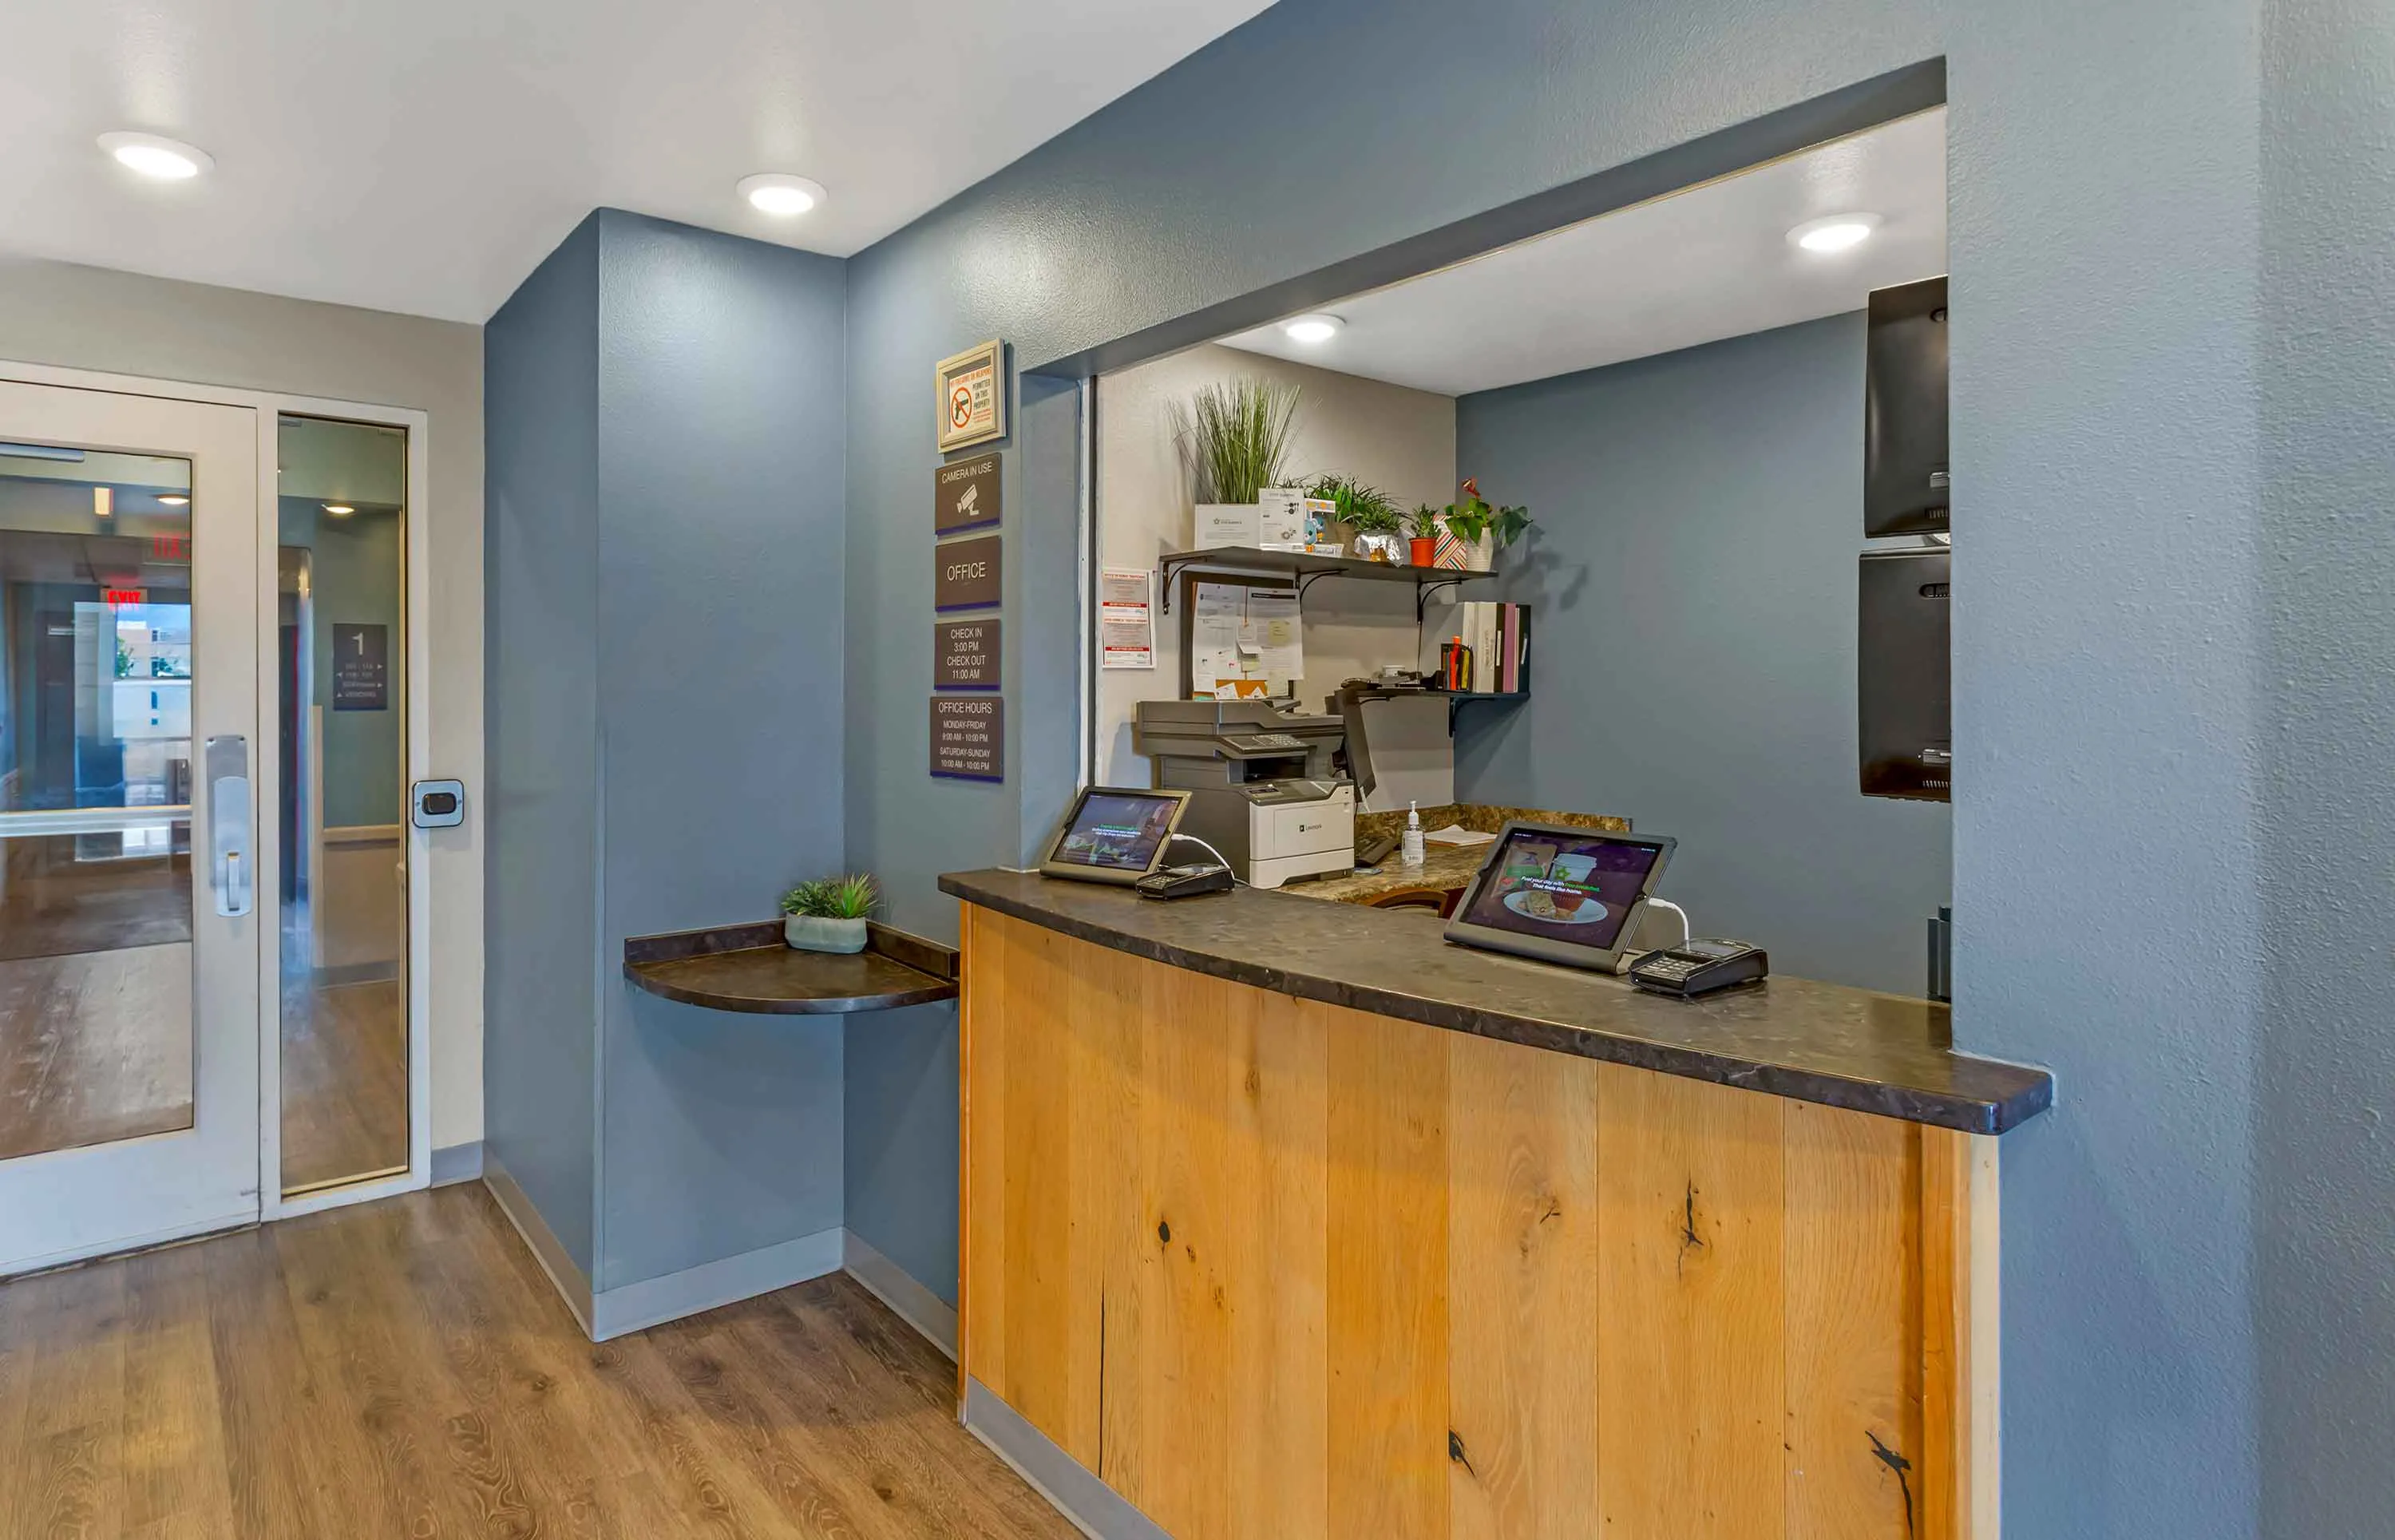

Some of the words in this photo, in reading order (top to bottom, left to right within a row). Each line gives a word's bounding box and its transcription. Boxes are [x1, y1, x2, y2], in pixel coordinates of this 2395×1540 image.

[942, 467, 969, 484] CAMERA
[970, 465, 977, 477] IN
[978, 461, 992, 474] USE
[947, 562, 986, 581] OFFICE
[951, 628, 975, 639] CHECK
[975, 627, 983, 638] IN
[352, 632, 363, 655] 1
[954, 643, 967, 652] 3:00
[968, 641, 979, 651] PM
[947, 655, 970, 666] CHECK
[971, 655, 986, 665] OUT
[952, 670, 968, 679] 11:00
[969, 669, 980, 679] AM
[938, 703, 964, 713] OFFICE
[965, 703, 992, 714] HOURS
